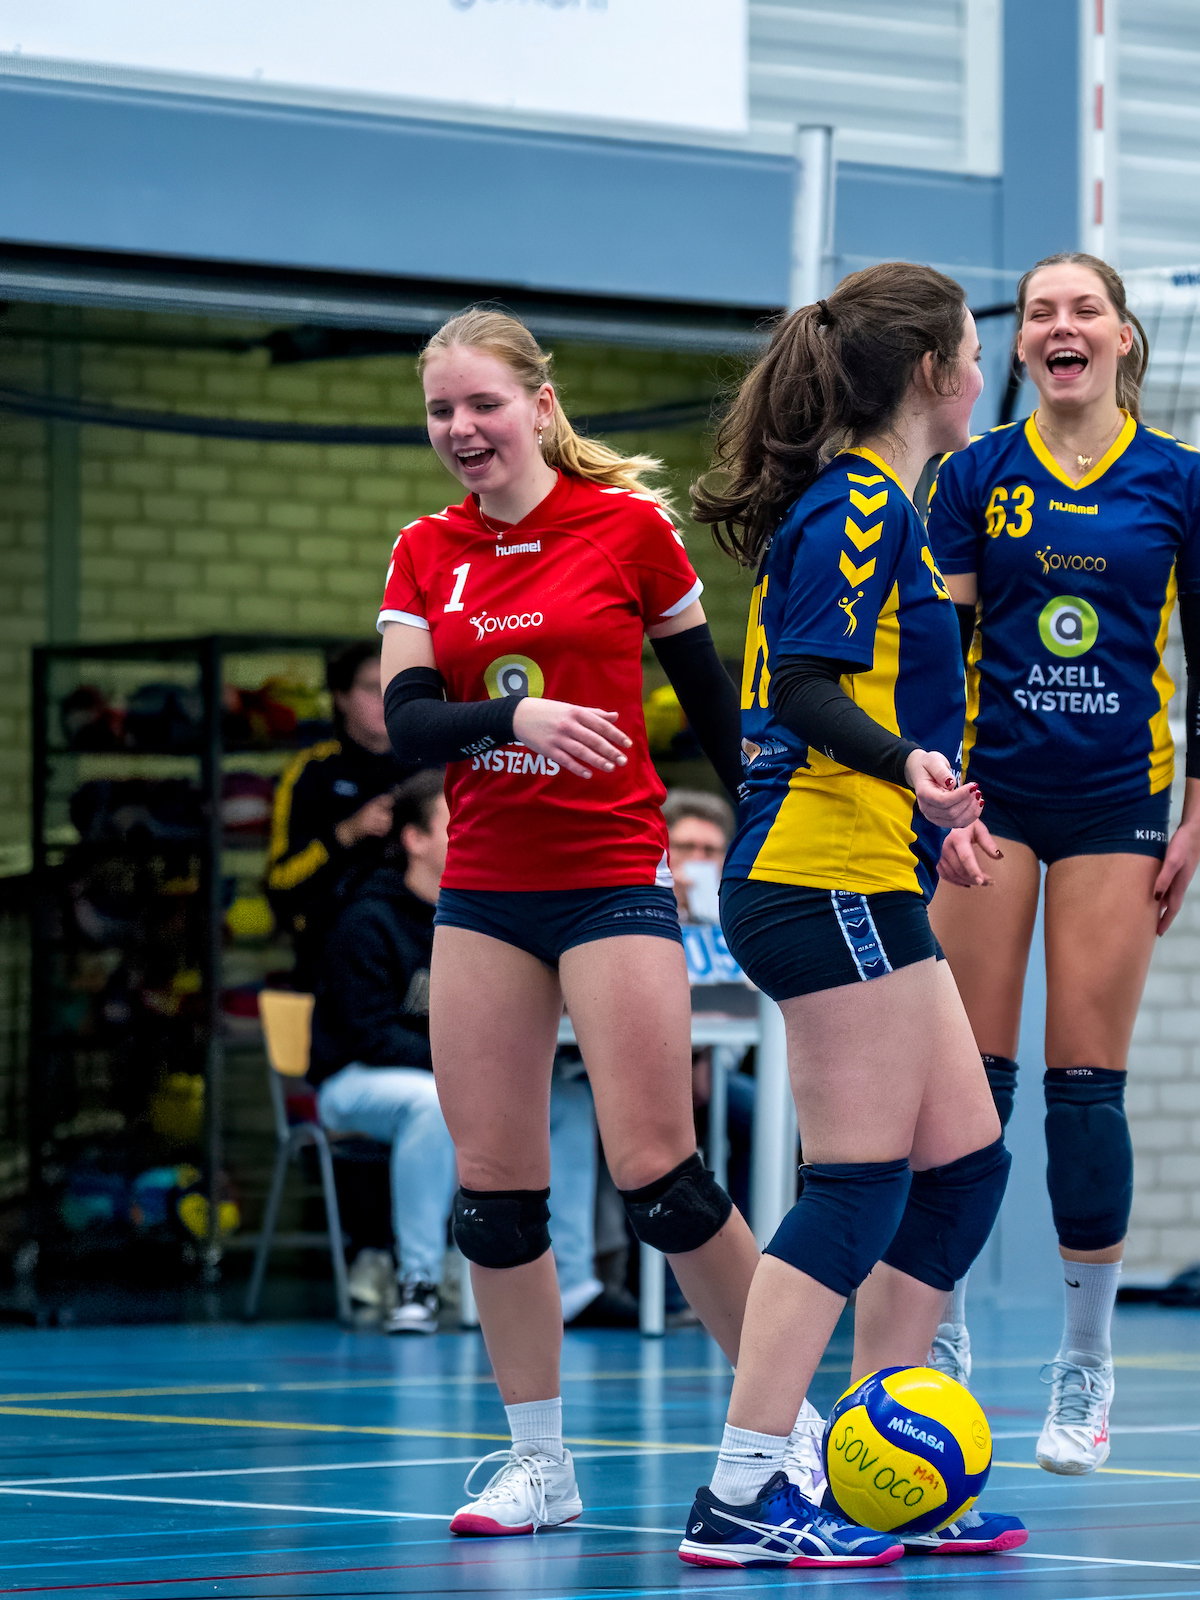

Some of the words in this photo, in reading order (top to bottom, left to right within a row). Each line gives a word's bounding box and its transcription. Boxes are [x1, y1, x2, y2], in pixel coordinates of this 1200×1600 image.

[985, 485, 1035, 538] 63
[1049, 499, 1099, 515] hummel
[496, 540, 541, 557] hummel
[443, 563, 471, 613] 1
[1027, 664, 1106, 688] AXELL
[1013, 689, 1120, 714] SYSTEMS
